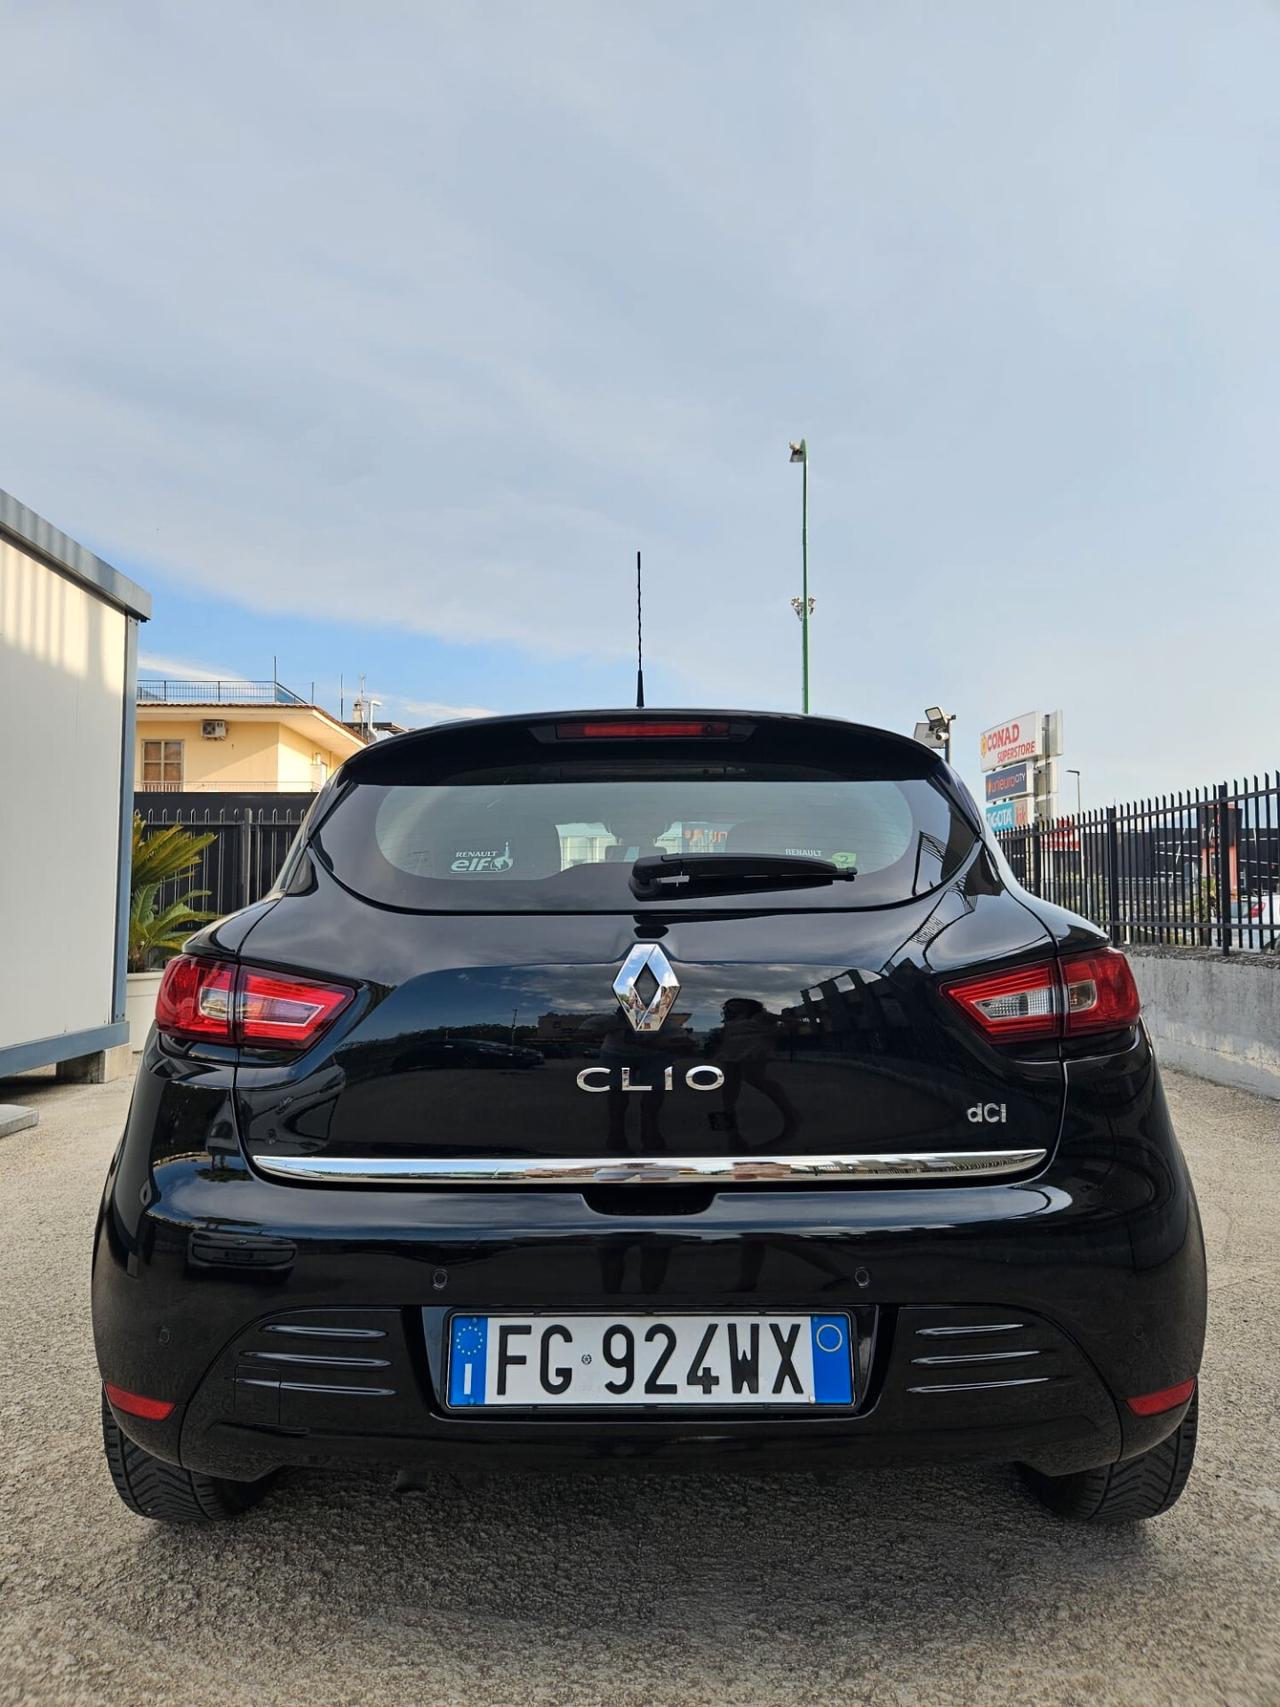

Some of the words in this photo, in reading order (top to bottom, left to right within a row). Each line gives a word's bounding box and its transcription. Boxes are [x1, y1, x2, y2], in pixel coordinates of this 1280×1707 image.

[987, 724, 1020, 751] CONAD
[997, 740, 1036, 763] SUPERSTORE
[455, 850, 498, 858] RENAULT
[785, 848, 822, 857] RENAULT
[576, 1065, 725, 1093] CLIO
[497, 1324, 573, 1396] FG
[602, 1323, 804, 1395] 924WX
